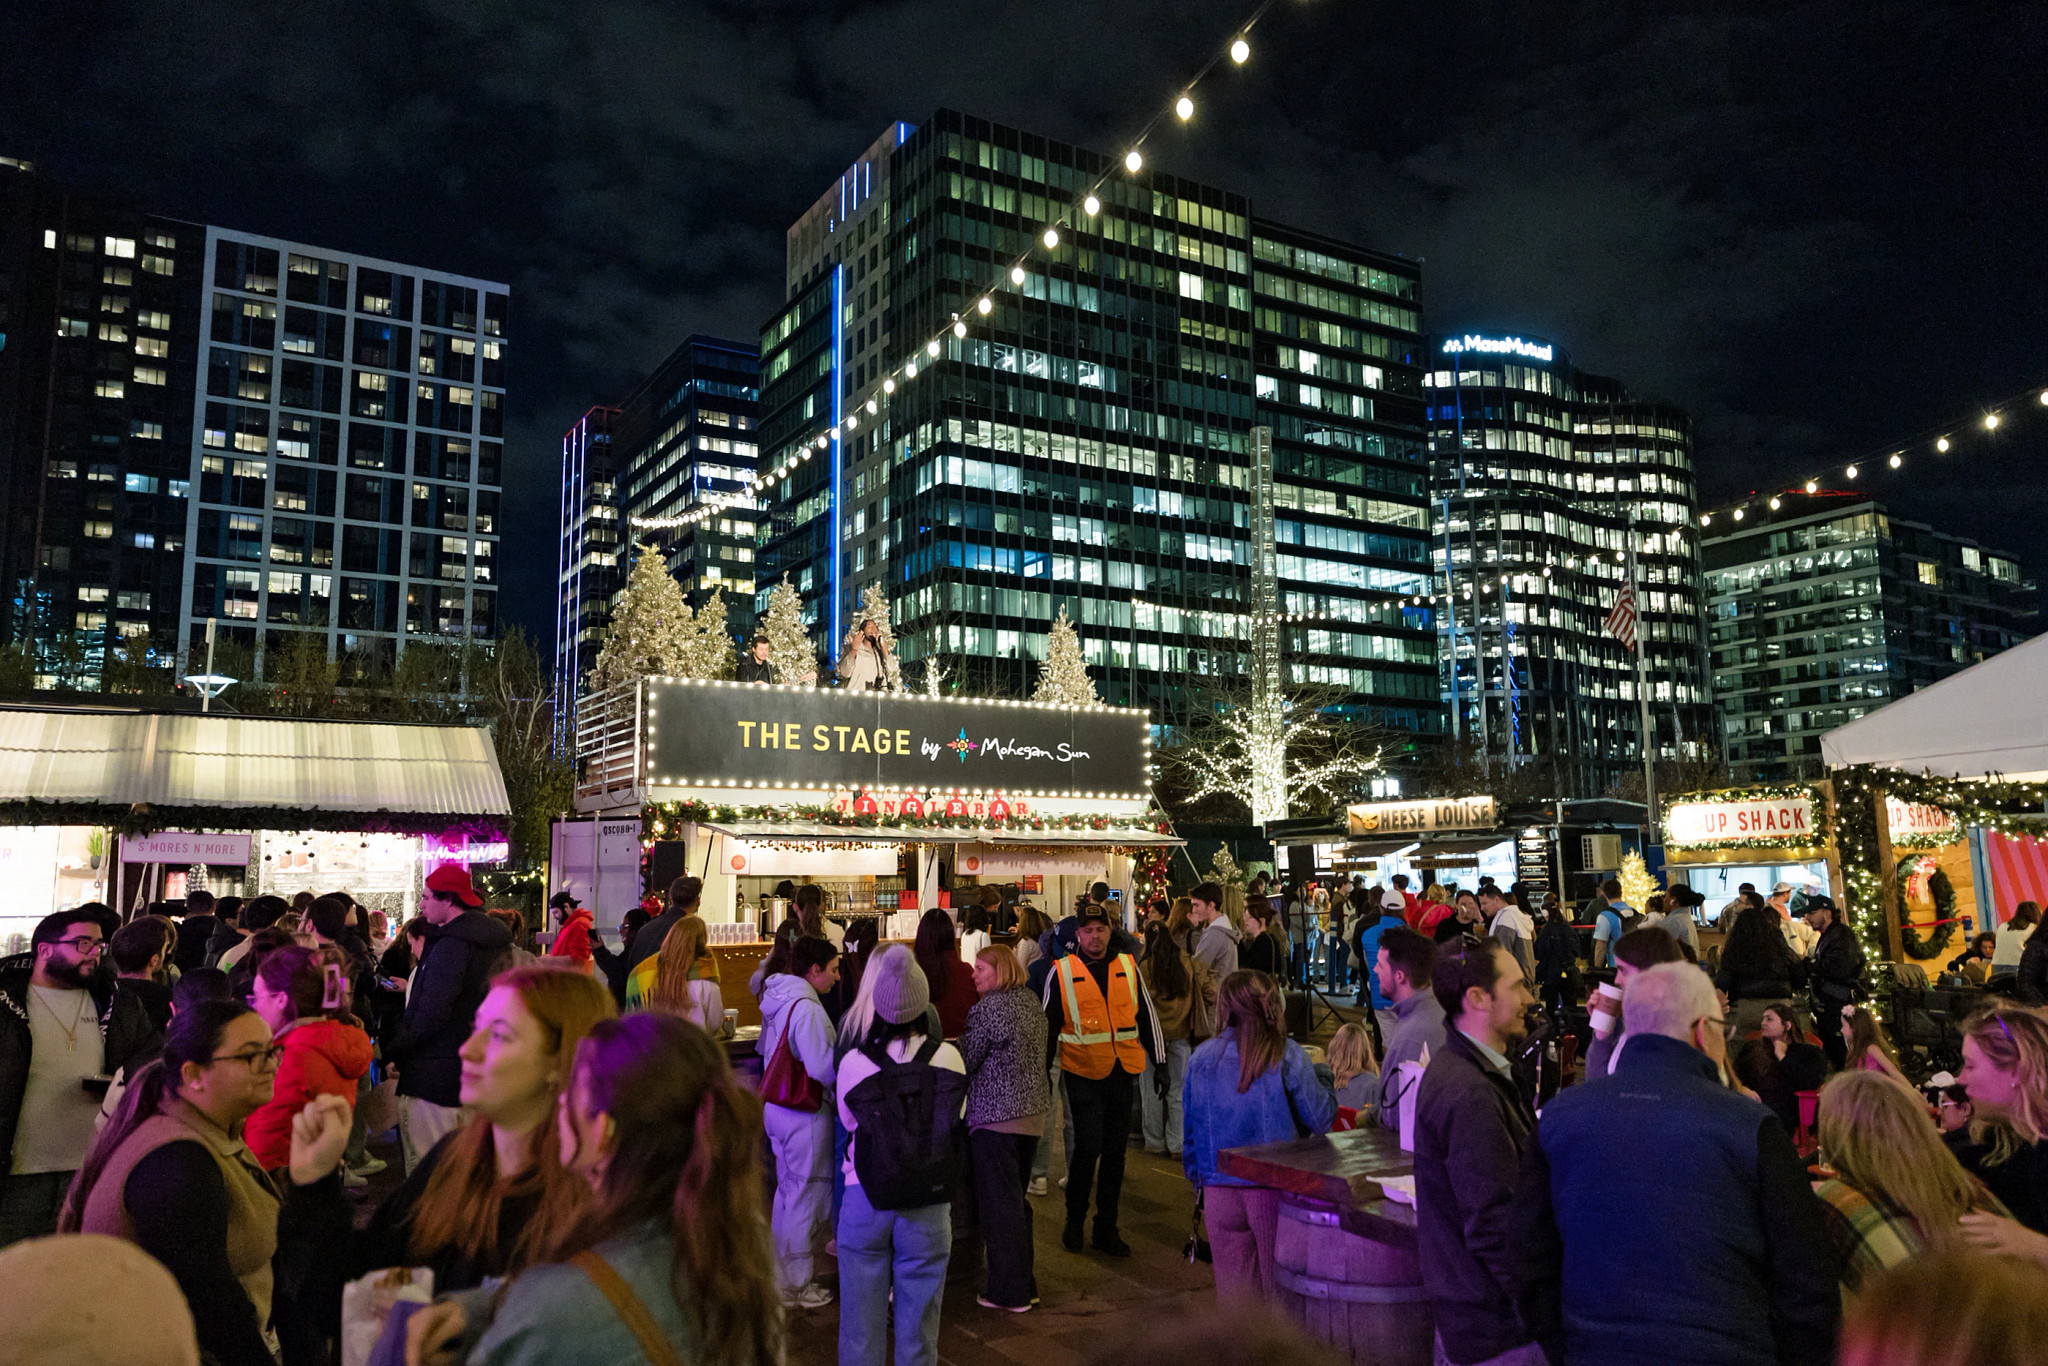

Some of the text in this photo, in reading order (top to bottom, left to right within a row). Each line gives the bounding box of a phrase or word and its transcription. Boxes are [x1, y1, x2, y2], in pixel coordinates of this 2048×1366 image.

[1464, 334, 1552, 361] MassMutual
[737, 720, 1091, 762] THE STAGE by Mohegan Sun
[1704, 807, 1806, 833] UP SHACK
[138, 841, 189, 853] S'MORES
